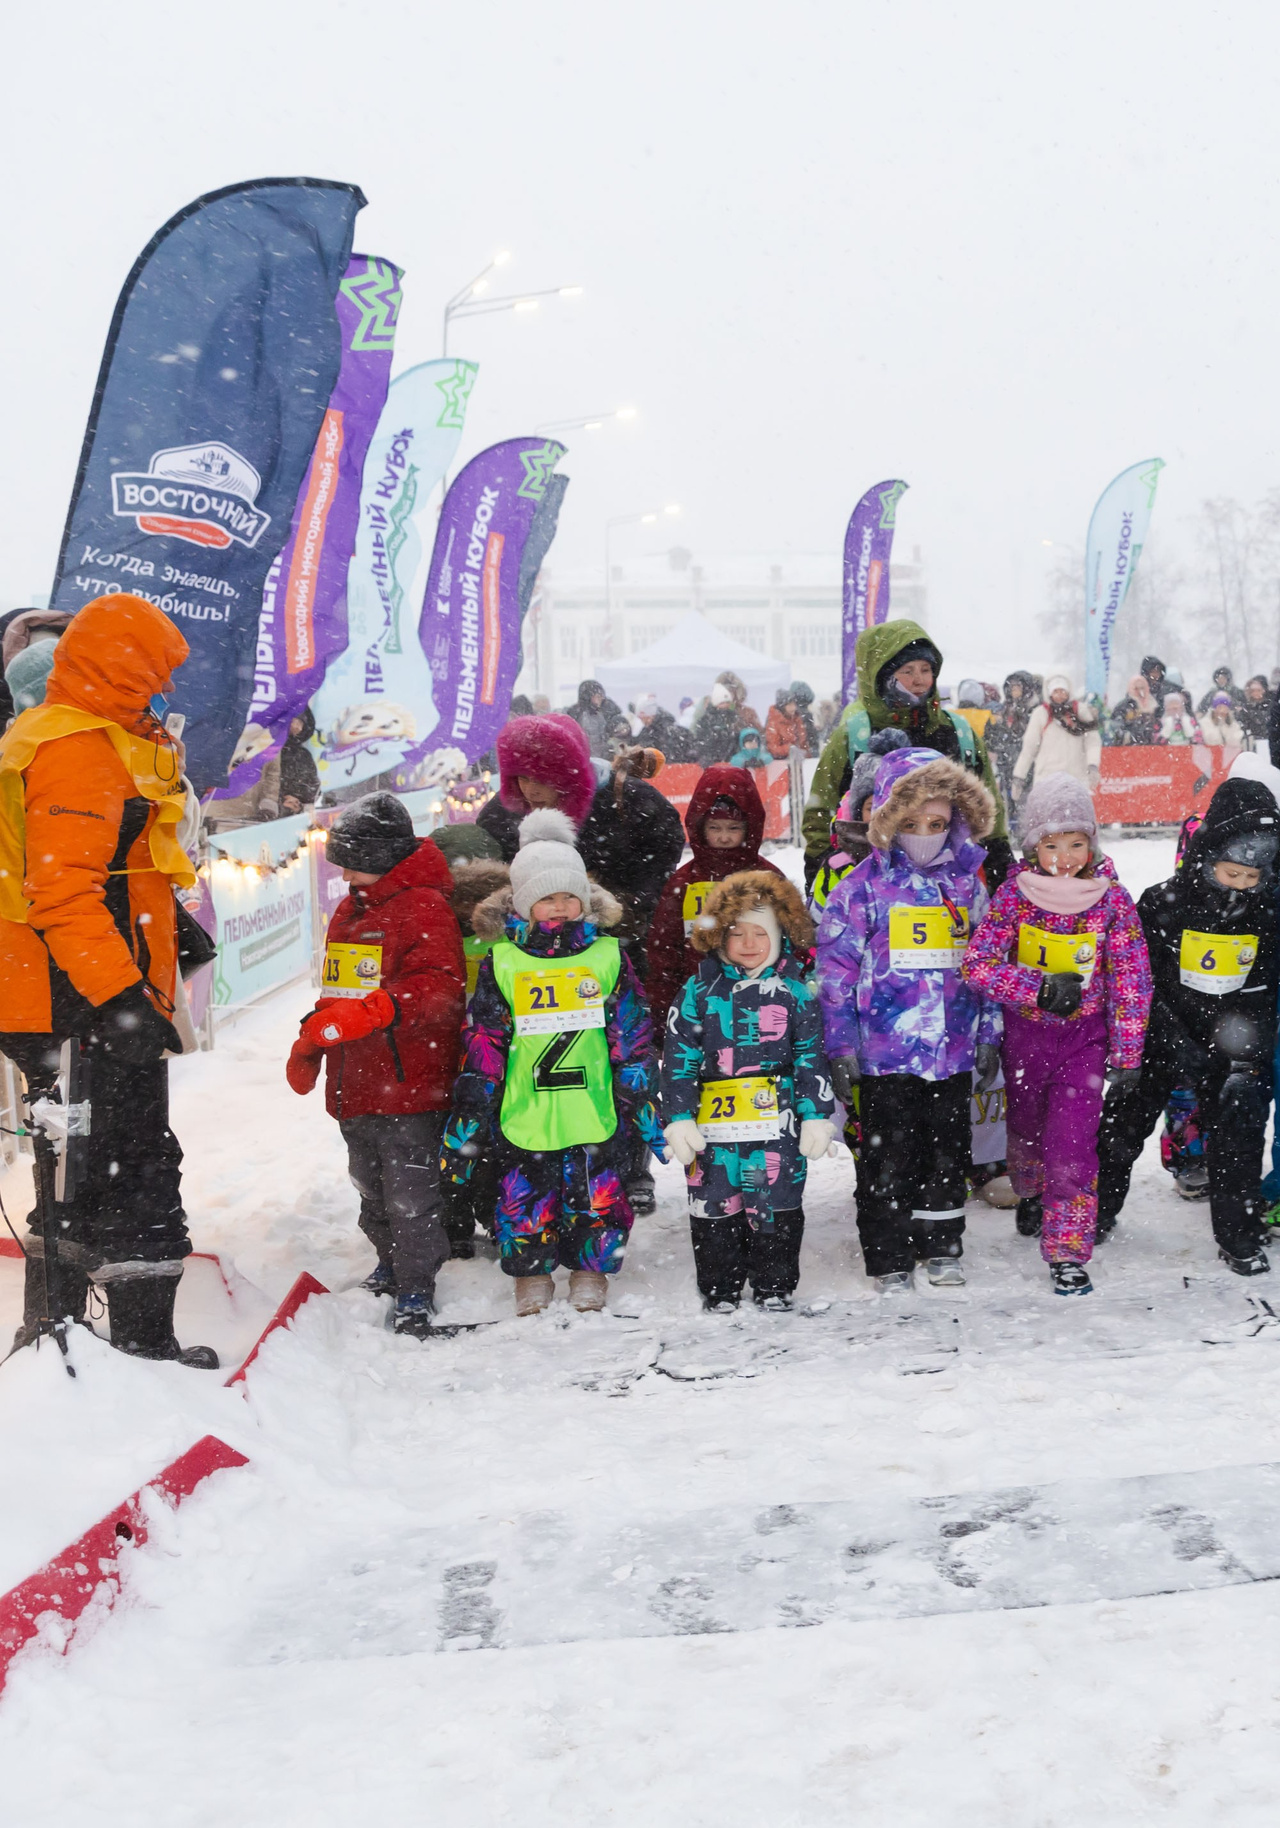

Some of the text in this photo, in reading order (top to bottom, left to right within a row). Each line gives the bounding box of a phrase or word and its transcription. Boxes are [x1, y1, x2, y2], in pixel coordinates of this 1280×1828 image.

[294, 416, 338, 669] Новогодний многодневный забег
[465, 486, 500, 571] КУБОК
[1116, 511, 1134, 575] КУБОК
[80, 545, 240, 600] Когда знаешь,
[857, 525, 873, 591] КУБОК
[75, 575, 122, 595] что
[451, 573, 480, 740] ПЕЛЬМЕННЫЙ
[224, 902, 287, 944] ПЕЛЬМЕННЫЙ
[912, 923, 927, 945] 5
[326, 958, 340, 982] 13
[1036, 945, 1048, 967] 1
[1200, 949, 1216, 970] 6
[529, 985, 559, 1010] 21
[709, 1095, 736, 1119] 23
